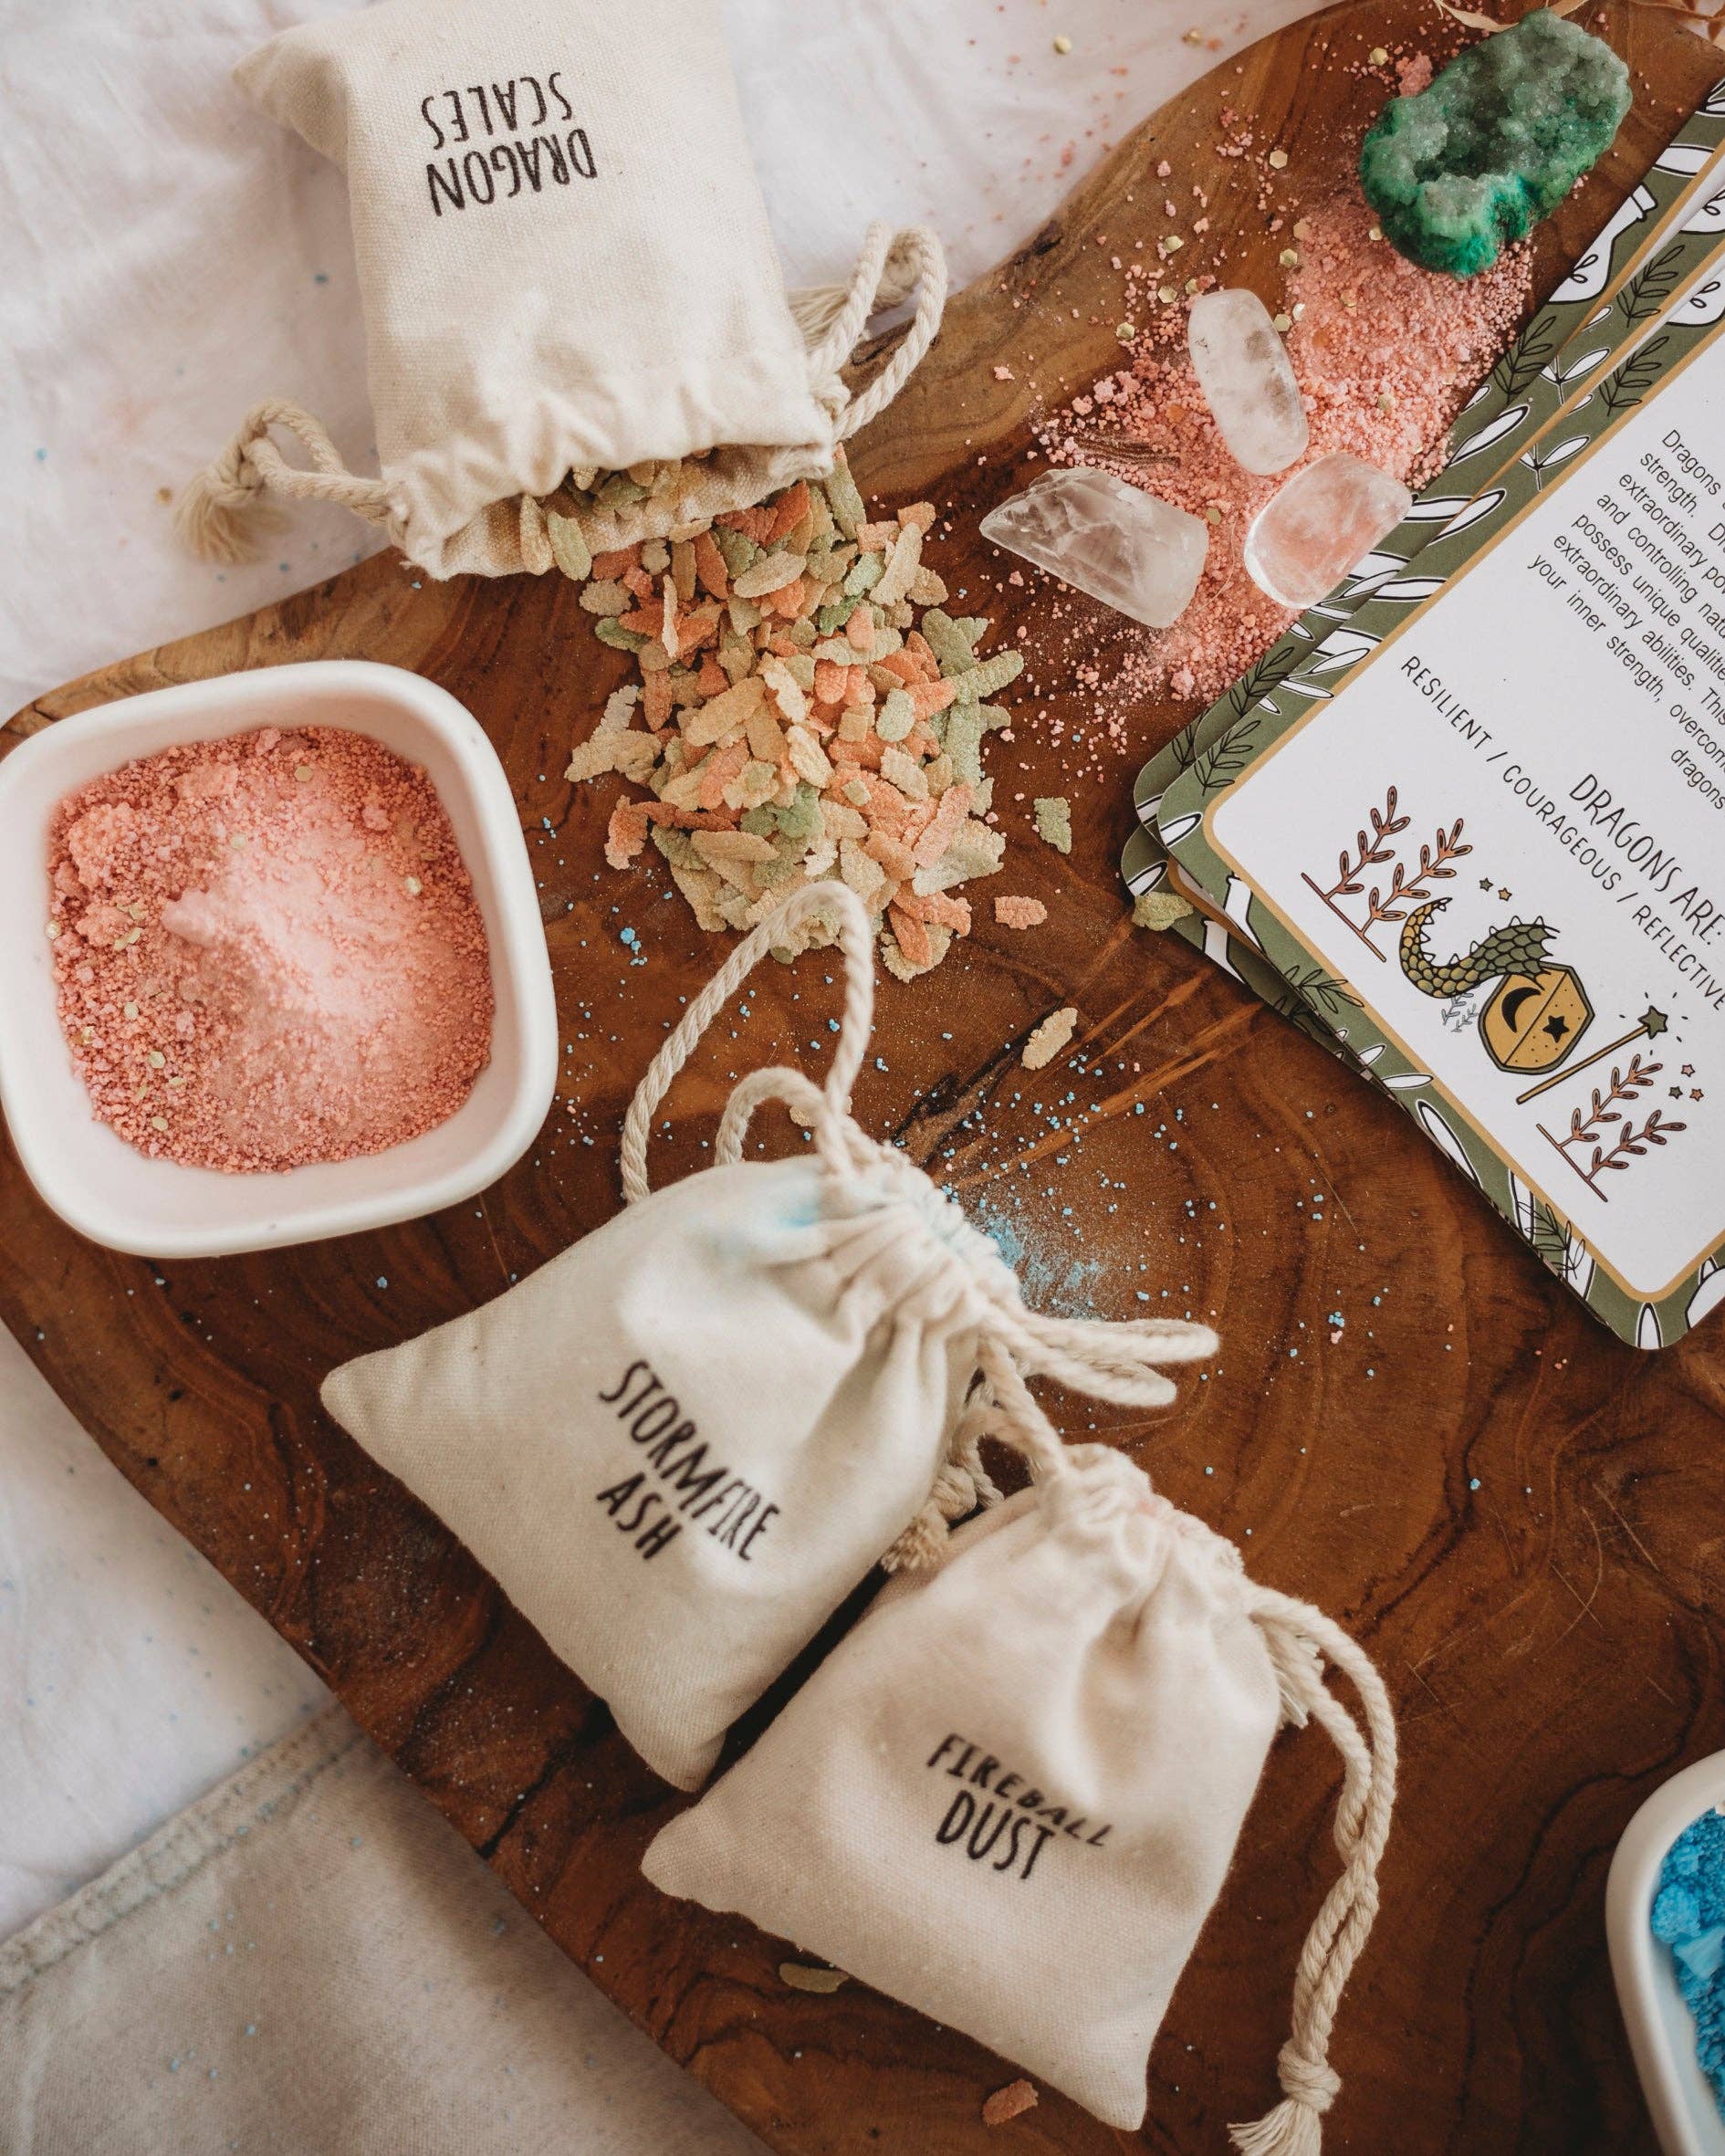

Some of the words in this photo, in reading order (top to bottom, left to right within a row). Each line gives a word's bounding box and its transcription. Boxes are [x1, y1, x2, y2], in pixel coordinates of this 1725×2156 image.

[421, 71, 573, 151] SCALES
[425, 128, 598, 217] DRAGON
[1640, 453, 1698, 518] strength.
[1708, 522, 1725, 553] Dr
[1662, 429, 1721, 496] Dragons
[1571, 514, 1633, 575] possess
[1633, 575, 1680, 627] unique
[1596, 494, 1631, 525] and
[1627, 527, 1699, 604] controlling
[1618, 472, 1709, 568] extraordinary
[1701, 566, 1725, 595] po
[1527, 553, 1567, 590] your
[1566, 590, 1606, 632] inner
[1606, 636, 1664, 703] strength,
[1669, 704, 1725, 772] overcom
[1553, 535, 1643, 629] extraordinary
[1642, 631, 1695, 691] abilities.
[1400, 655, 1493, 751] RESILIENT
[1502, 765, 1622, 891] COURAGEOUS
[1632, 905, 1725, 1011] REFLECTIVE
[1670, 748, 1725, 810] dragons
[1569, 773, 1683, 893] DRAGONS
[1669, 886, 1725, 946] ARE:
[596, 1470, 683, 1560] ASH
[598, 1358, 780, 1561] STORMFIRE
[926, 1732, 1113, 1847] FIREBALL
[936, 1789, 1056, 1880] DUST
